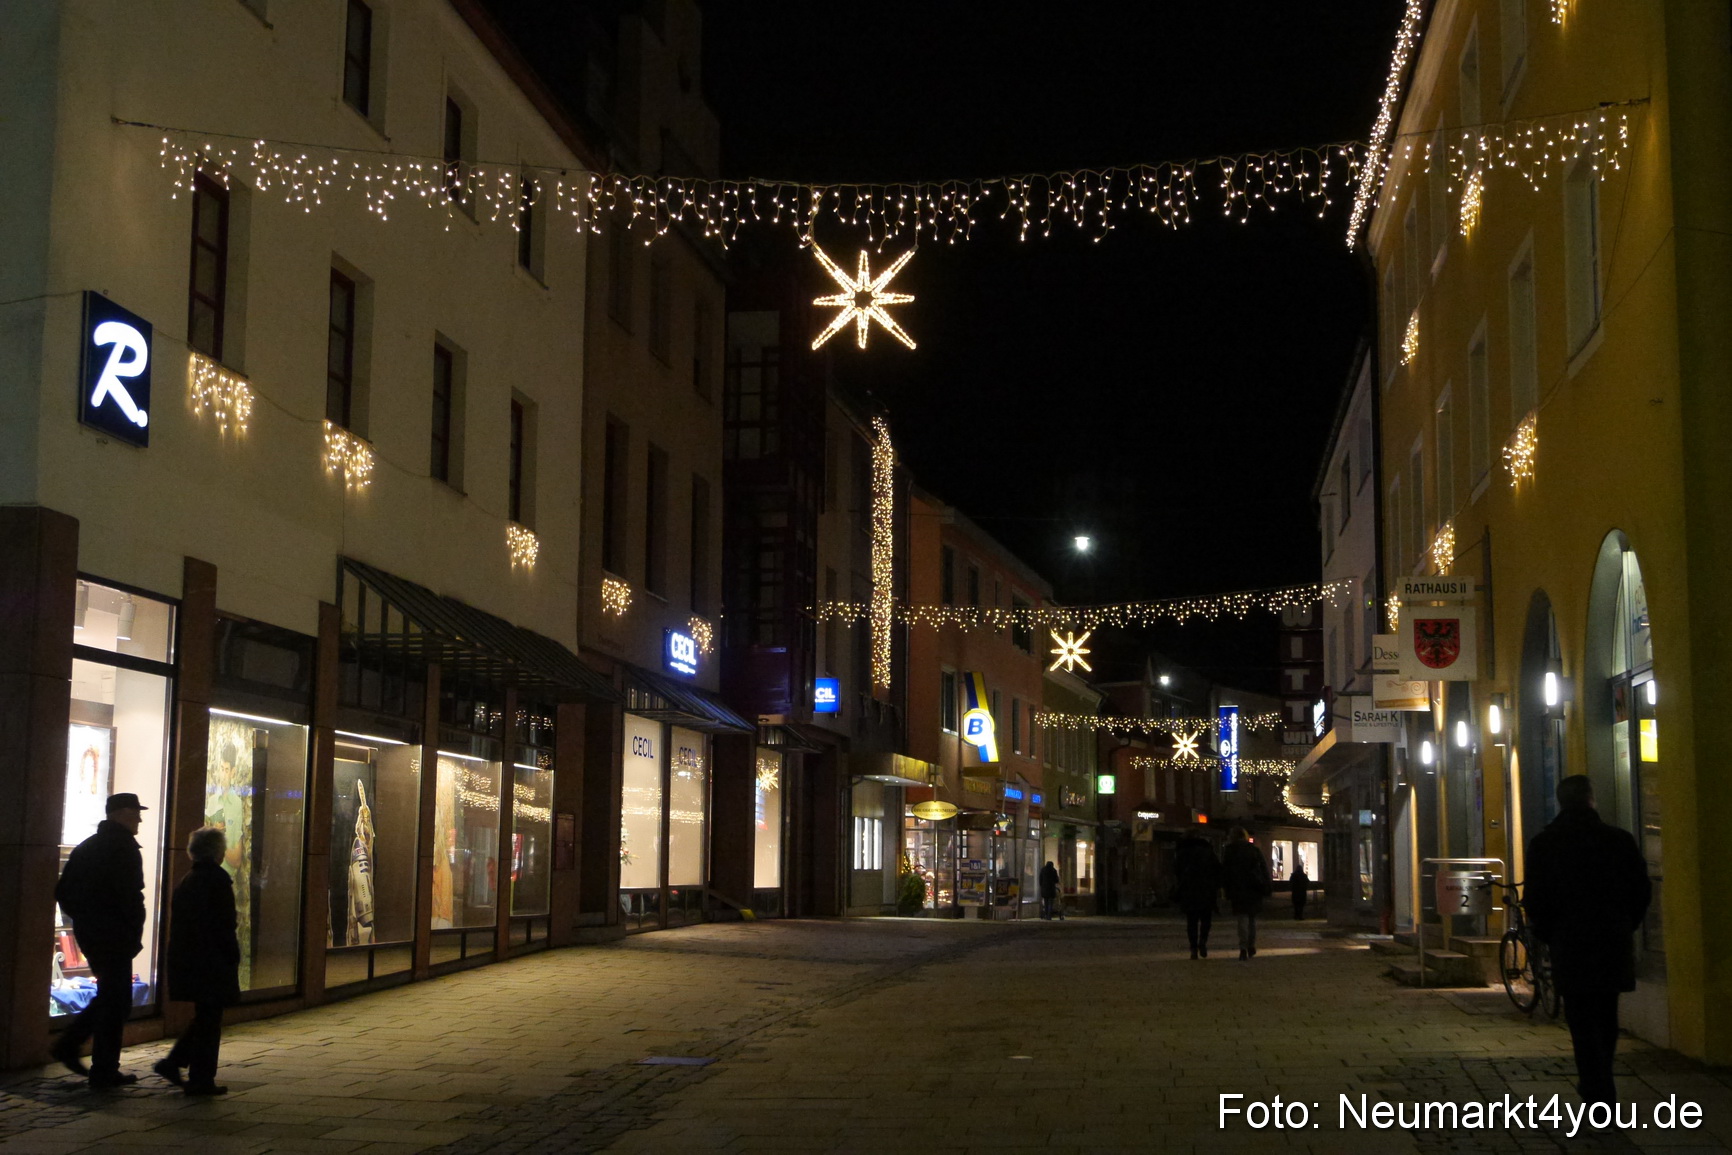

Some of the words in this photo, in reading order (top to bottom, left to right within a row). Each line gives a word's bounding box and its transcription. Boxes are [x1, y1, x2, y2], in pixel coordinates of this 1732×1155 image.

[91, 321, 148, 428] R
[1404, 583, 1457, 594] RATHAUS
[671, 632, 697, 666] CECIL
[1390, 710, 1398, 722] K
[967, 718, 984, 736] B
[632, 735, 654, 759] CECIL
[679, 746, 698, 768] CECIL
[1461, 894, 1470, 908] 2
